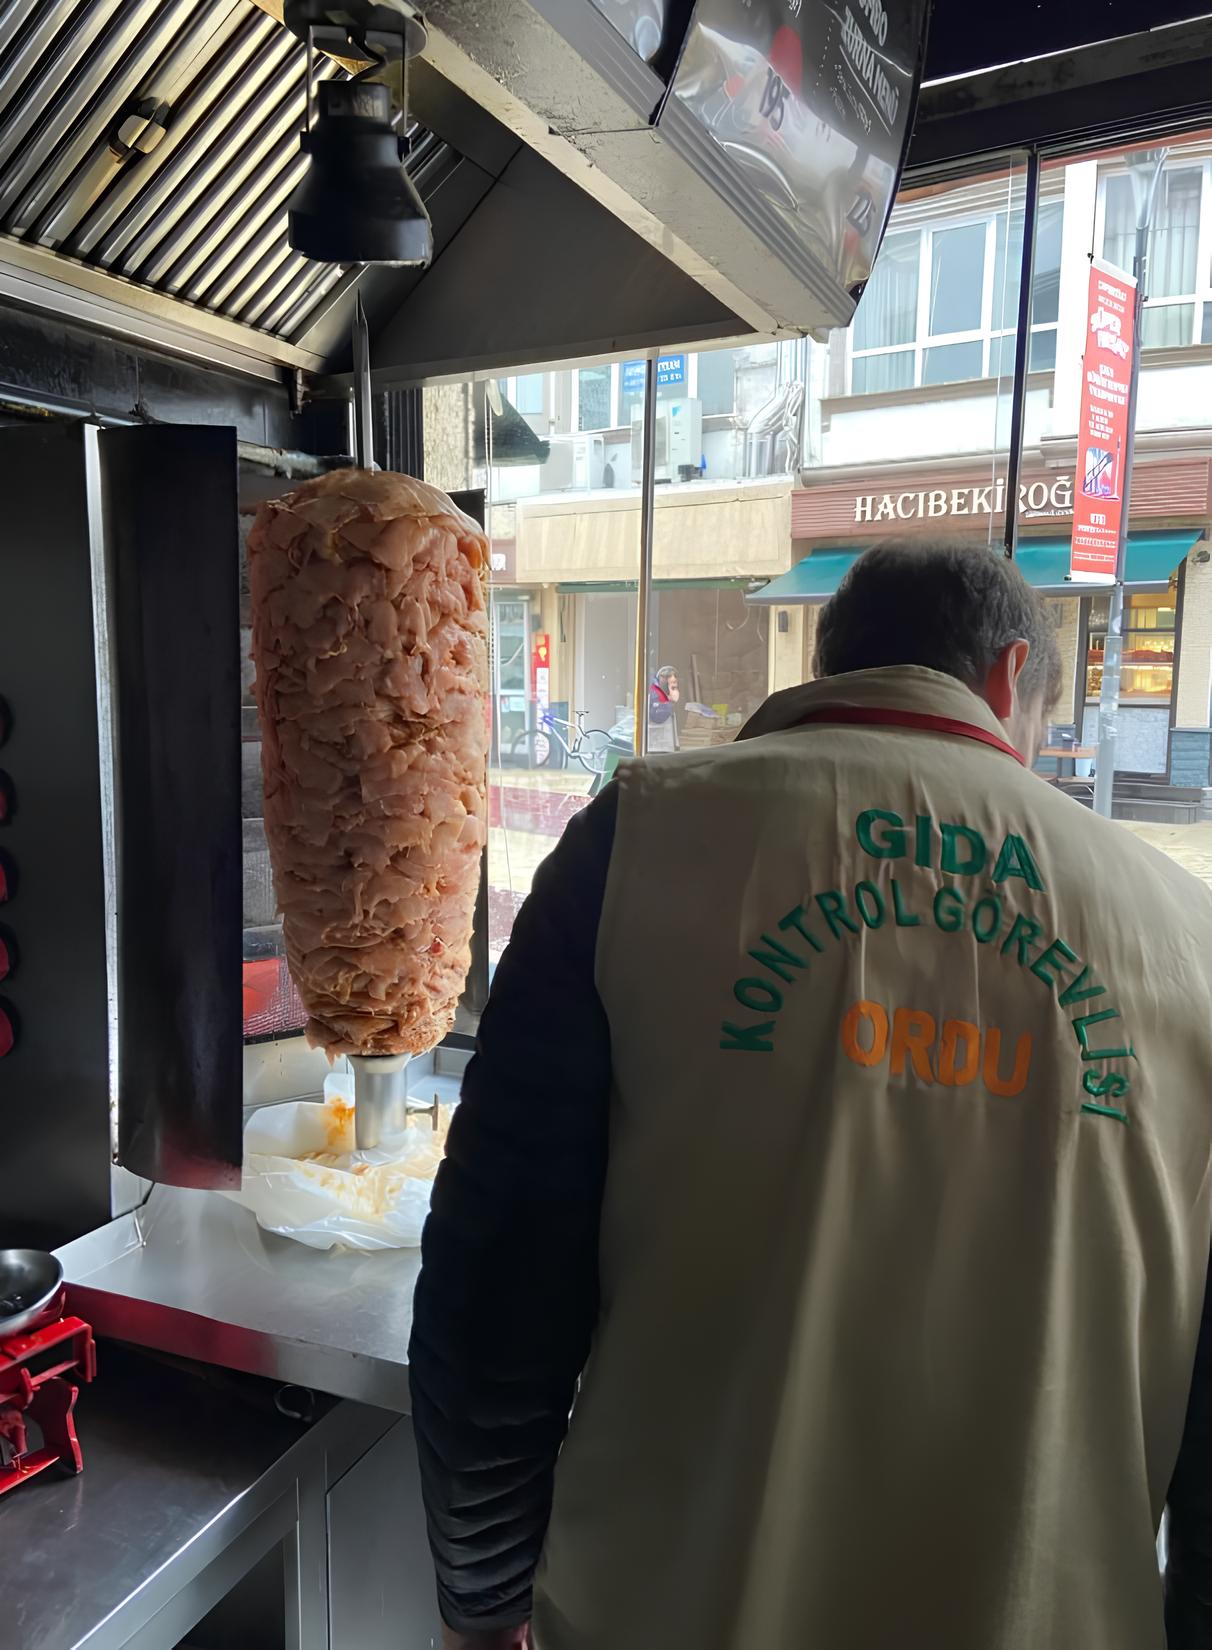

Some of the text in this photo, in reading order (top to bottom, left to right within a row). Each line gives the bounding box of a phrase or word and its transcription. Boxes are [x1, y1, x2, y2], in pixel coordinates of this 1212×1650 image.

[856, 808, 1047, 892] GIDA
[720, 879, 921, 1052] KONTROL
[841, 1000, 1033, 1097] ORDU
